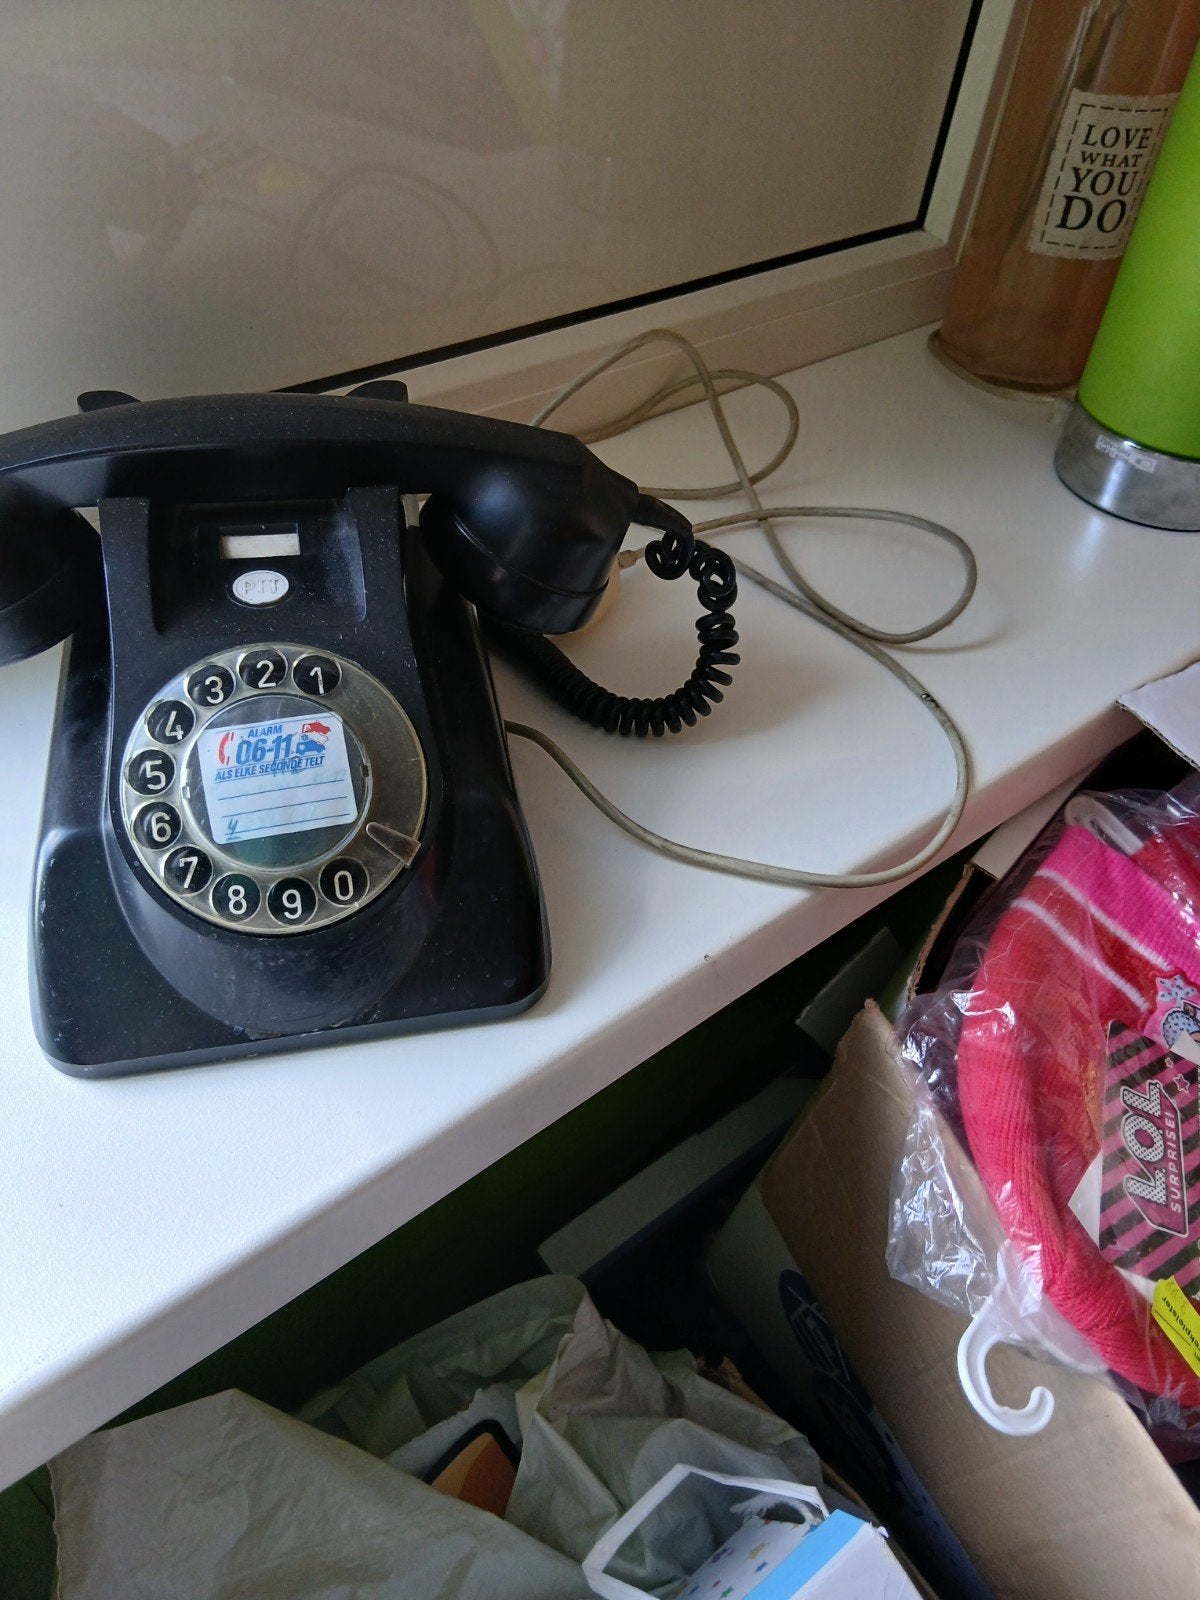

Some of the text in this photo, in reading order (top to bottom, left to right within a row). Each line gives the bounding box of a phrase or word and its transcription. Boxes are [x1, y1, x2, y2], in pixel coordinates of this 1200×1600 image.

[1081, 124, 1153, 150] LOVE
[1081, 150, 1143, 168] WHAT
[1070, 166, 1139, 197] YOU
[1056, 194, 1127, 233] DO
[244, 579, 279, 595] PTT
[256, 660, 276, 688] 2
[309, 666, 325, 694] 1
[204, 675, 224, 704] 3
[165, 710, 184, 740] 4
[248, 724, 283, 738] ALARM
[235, 733, 294, 766] 06-11
[145, 759, 166, 790] 5
[214, 755, 326, 782] ALS ELKE SECONDE TELT
[151, 811, 172, 842] 6
[179, 856, 199, 889] 7
[333, 870, 354, 901] 0
[226, 885, 247, 915] 8
[281, 889, 303, 920] 9
[1164, 1109, 1182, 1214] SURPRISE!
